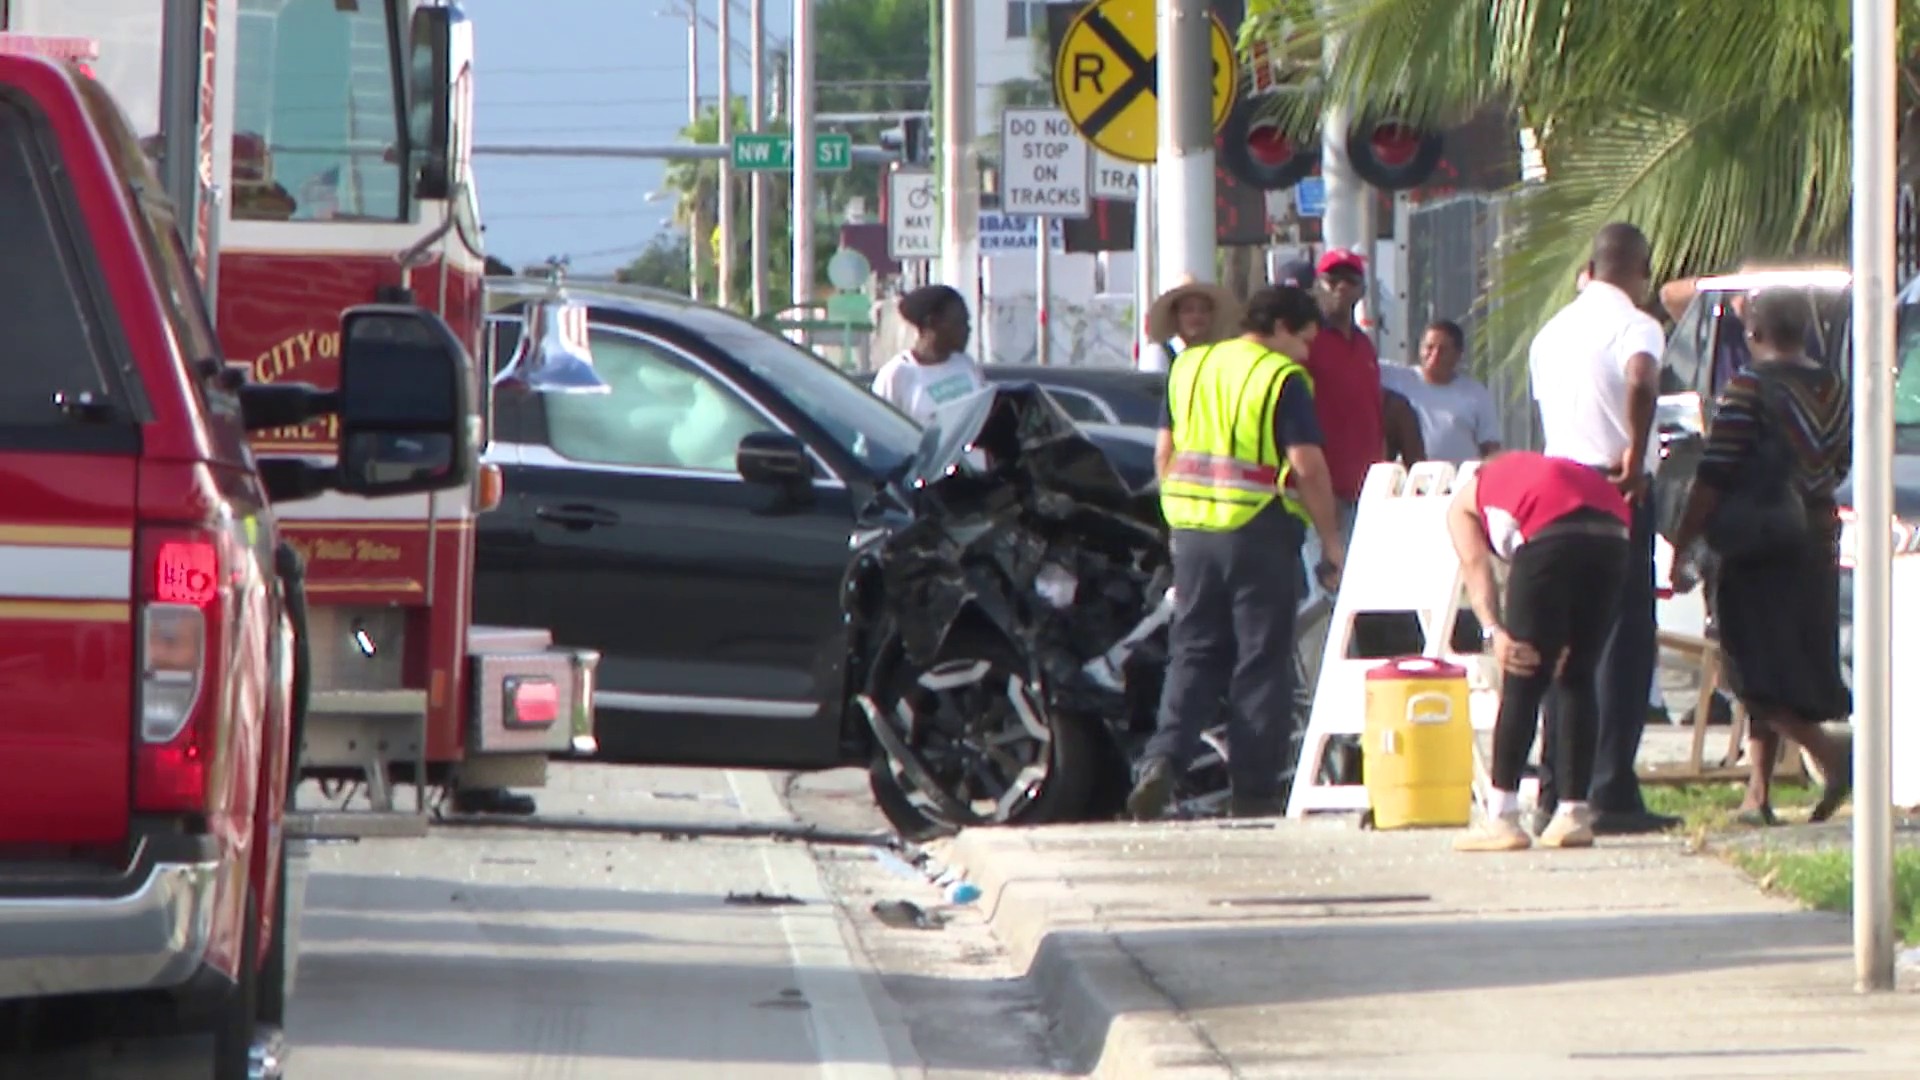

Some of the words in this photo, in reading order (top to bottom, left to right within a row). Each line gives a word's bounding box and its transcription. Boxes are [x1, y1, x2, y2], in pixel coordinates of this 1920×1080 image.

[1073, 52, 1105, 93] R
[1010, 119, 1036, 136] DO
[738, 142, 770, 163] NW
[819, 141, 843, 163] ST
[1022, 143, 1069, 159] STOP
[1033, 165, 1058, 182] ON
[1011, 188, 1081, 205] TRACKS
[905, 216, 931, 229] MAY
[256, 330, 315, 385] CITY
